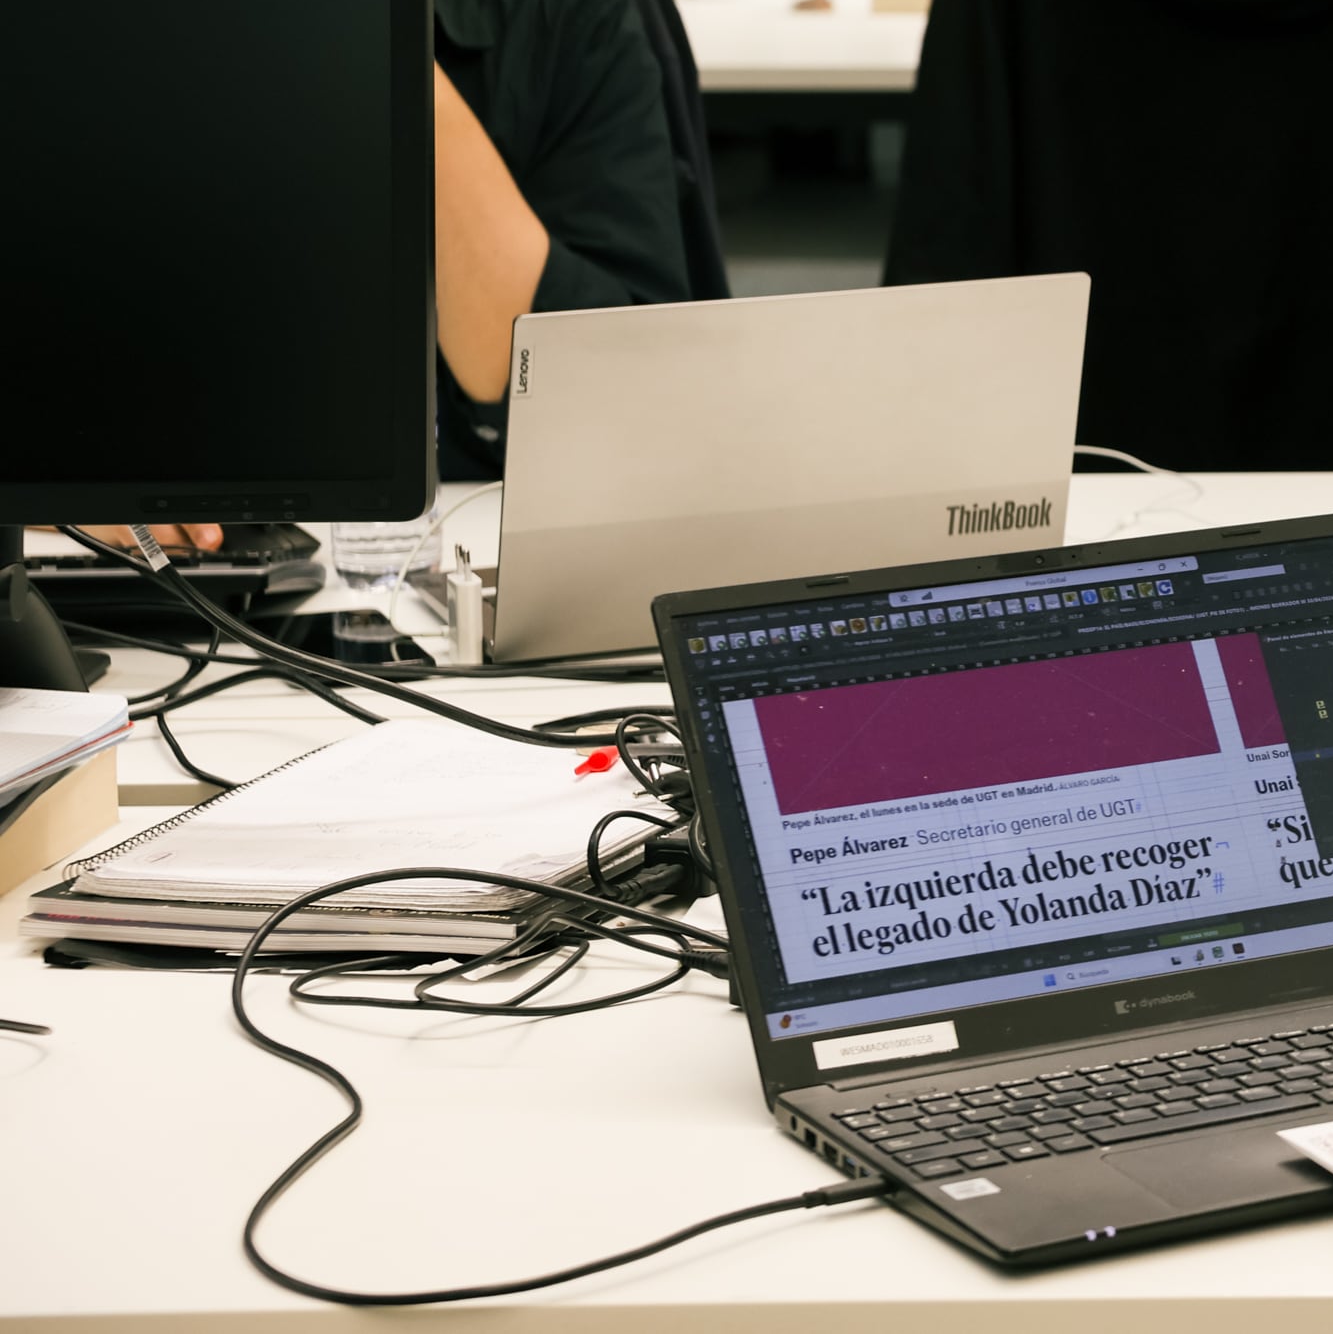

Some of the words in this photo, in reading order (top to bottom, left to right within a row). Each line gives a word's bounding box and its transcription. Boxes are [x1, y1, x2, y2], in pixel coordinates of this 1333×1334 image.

[517, 349, 528, 394] Lenovo
[946, 497, 1052, 536] ThinkBook
[790, 847, 836, 863] Pepe
[842, 835, 908, 857] Álvarez
[917, 822, 1006, 845] Secretario
[1012, 808, 1072, 835] general
[1077, 802, 1097, 821] de
[801, 886, 860, 916] “La
[865, 861, 1016, 910] izquierda
[1022, 850, 1095, 884] debe
[1105, 835, 1212, 873] recoger
[812, 926, 839, 957] el
[845, 911, 952, 955] legado
[958, 903, 994, 934] de
[999, 883, 1127, 928] Yolanda
[1139, 991, 1195, 1009] dynabook
